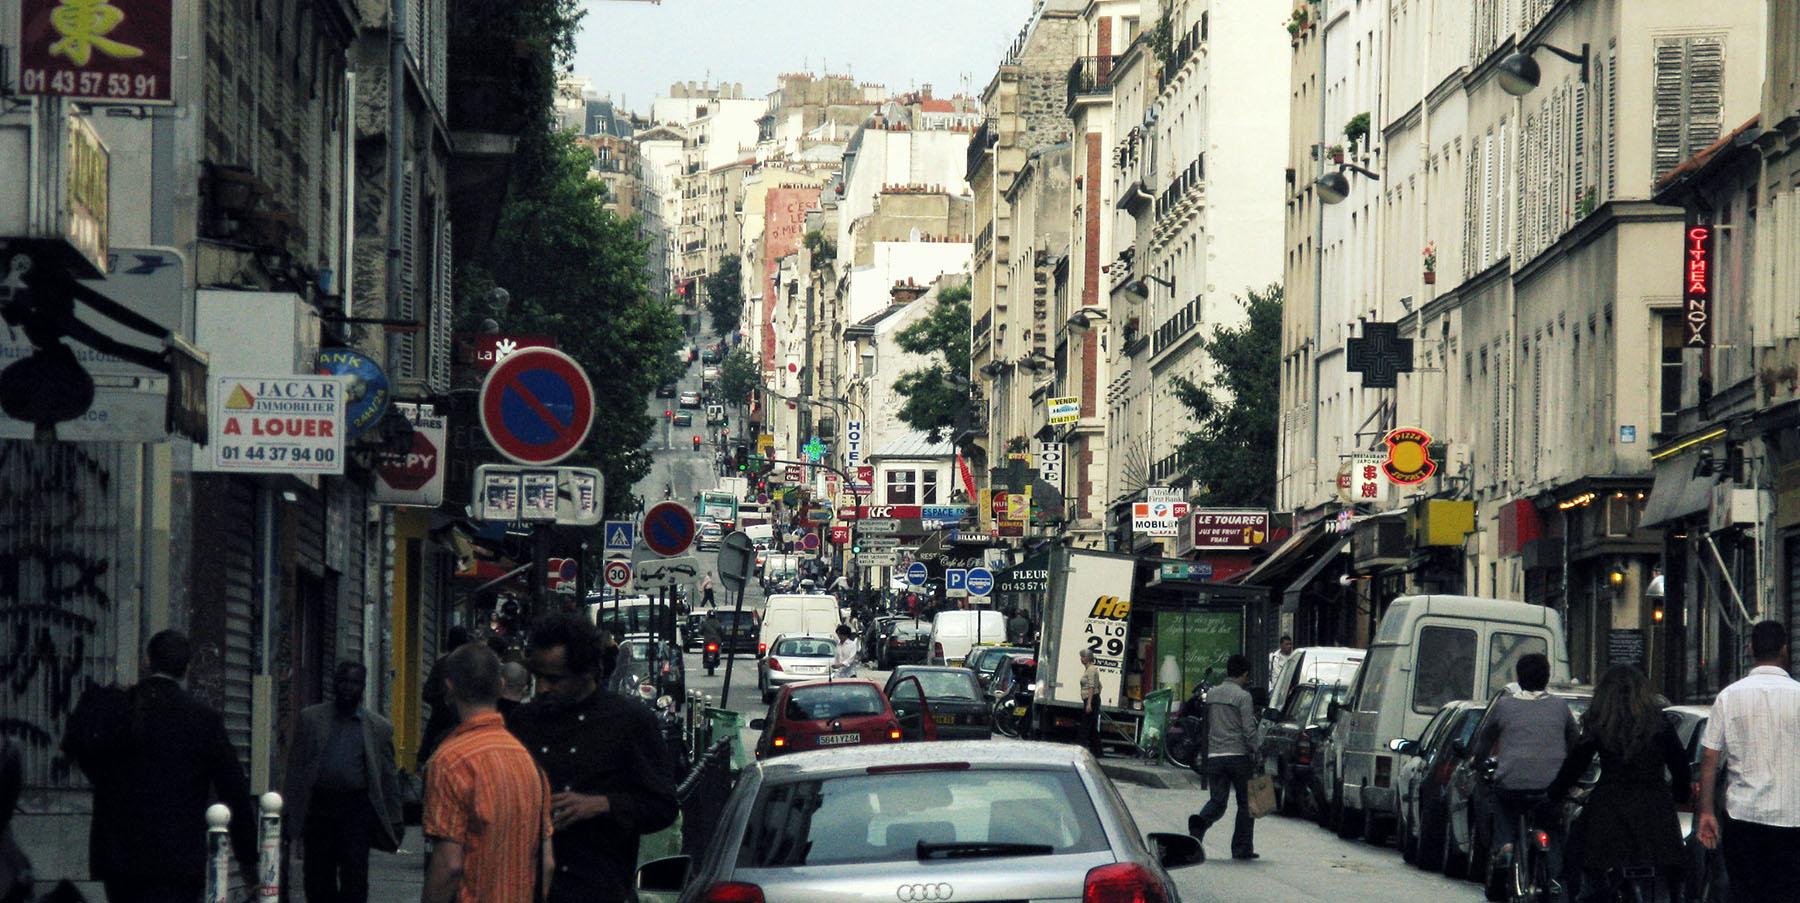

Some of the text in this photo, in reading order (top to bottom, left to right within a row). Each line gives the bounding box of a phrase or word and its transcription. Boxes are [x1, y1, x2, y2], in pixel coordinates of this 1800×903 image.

[23, 69, 156, 97] 01 43 57 53 91
[1688, 228, 1708, 344] CITHEA NOVA
[256, 382, 336, 398] JACAR
[256, 401, 335, 412] IMMOBILIER
[1054, 398, 1078, 406] VENDU
[223, 417, 335, 437] A LOUER
[1395, 432, 1422, 441] PIZZA
[222, 446, 335, 463] 01 44 37 94 00
[868, 506, 893, 518] KFC
[922, 507, 954, 517] ESPACE
[1198, 515, 1264, 525] LE TOUAREG
[1198, 528, 1241, 536] JUS DE FRUIT
[610, 569, 625, 580] 30
[951, 573, 961, 586] P
[1002, 583, 1012, 591] 01
[1014, 582, 1026, 591] 43
[1027, 582, 1038, 591] 57
[1089, 595, 1131, 621] He
[1085, 623, 1125, 637] A LO
[1087, 635, 1124, 656] 29
